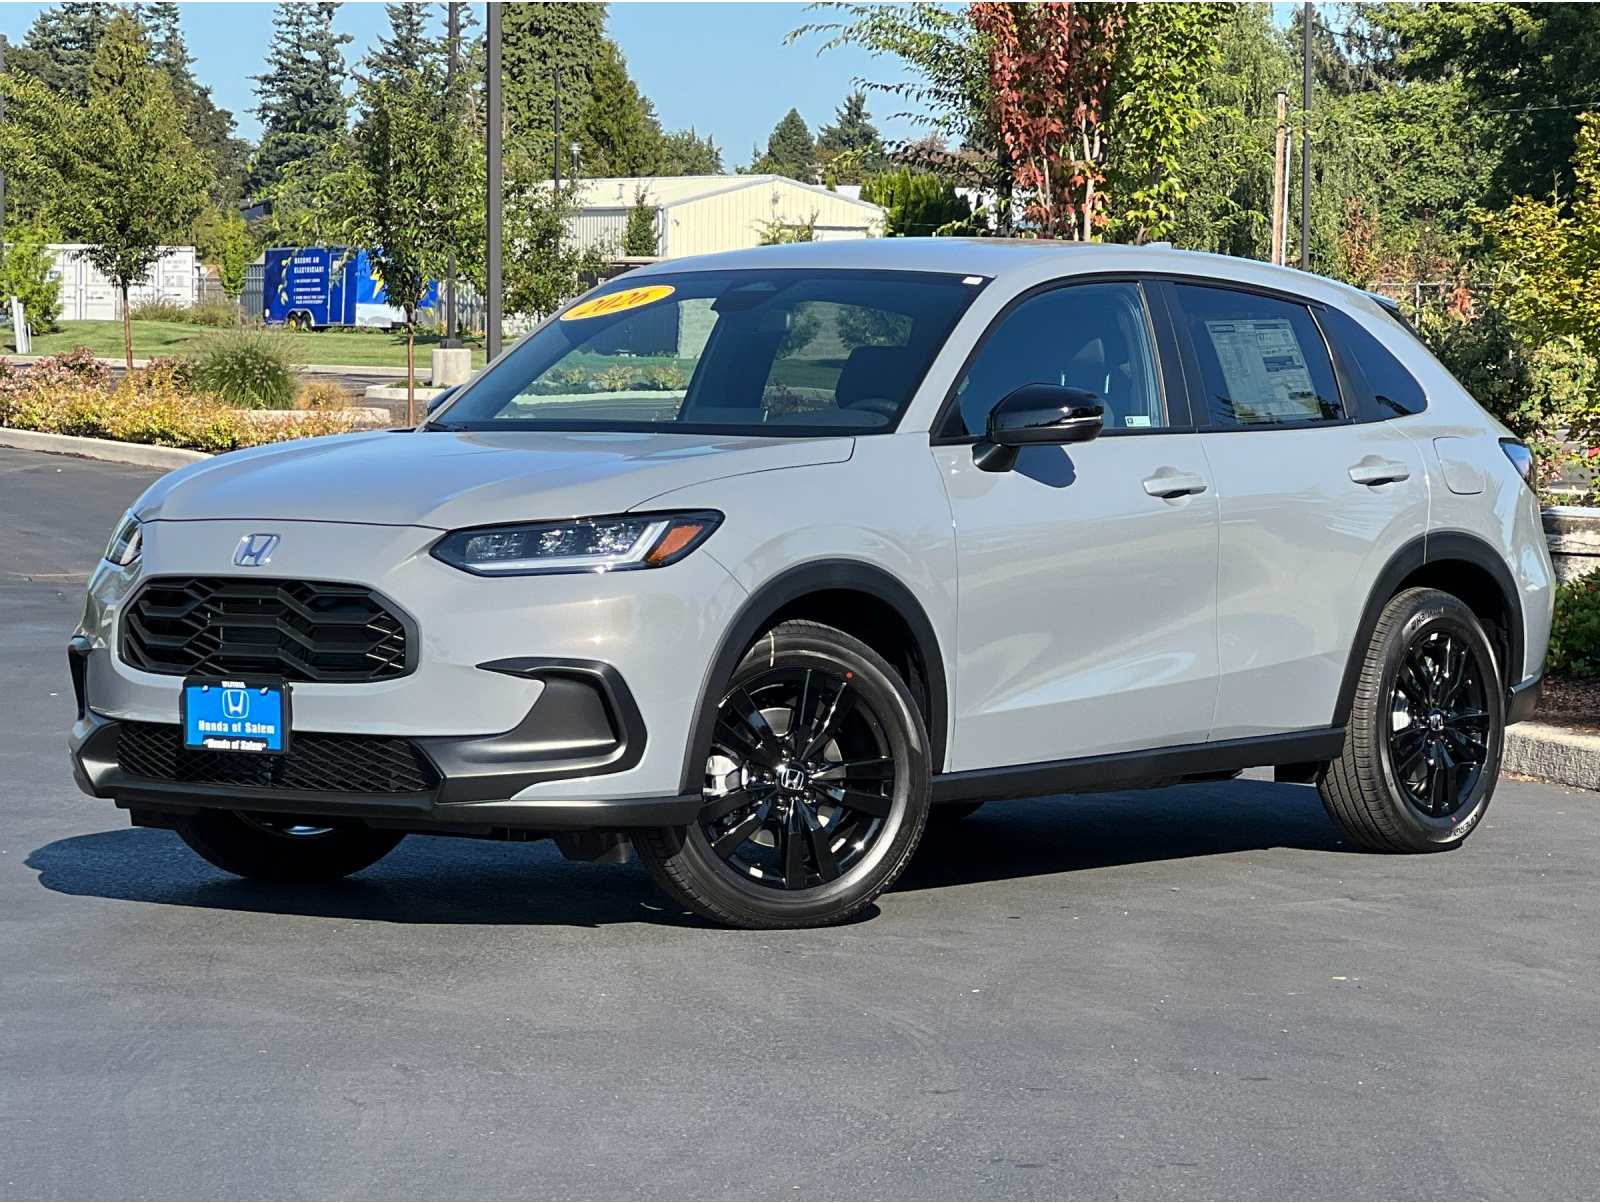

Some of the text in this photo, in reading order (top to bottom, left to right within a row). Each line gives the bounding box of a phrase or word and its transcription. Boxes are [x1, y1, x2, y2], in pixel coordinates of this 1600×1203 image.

[574, 290, 650, 317] 2026
[198, 720, 275, 735] Honda of Salem
